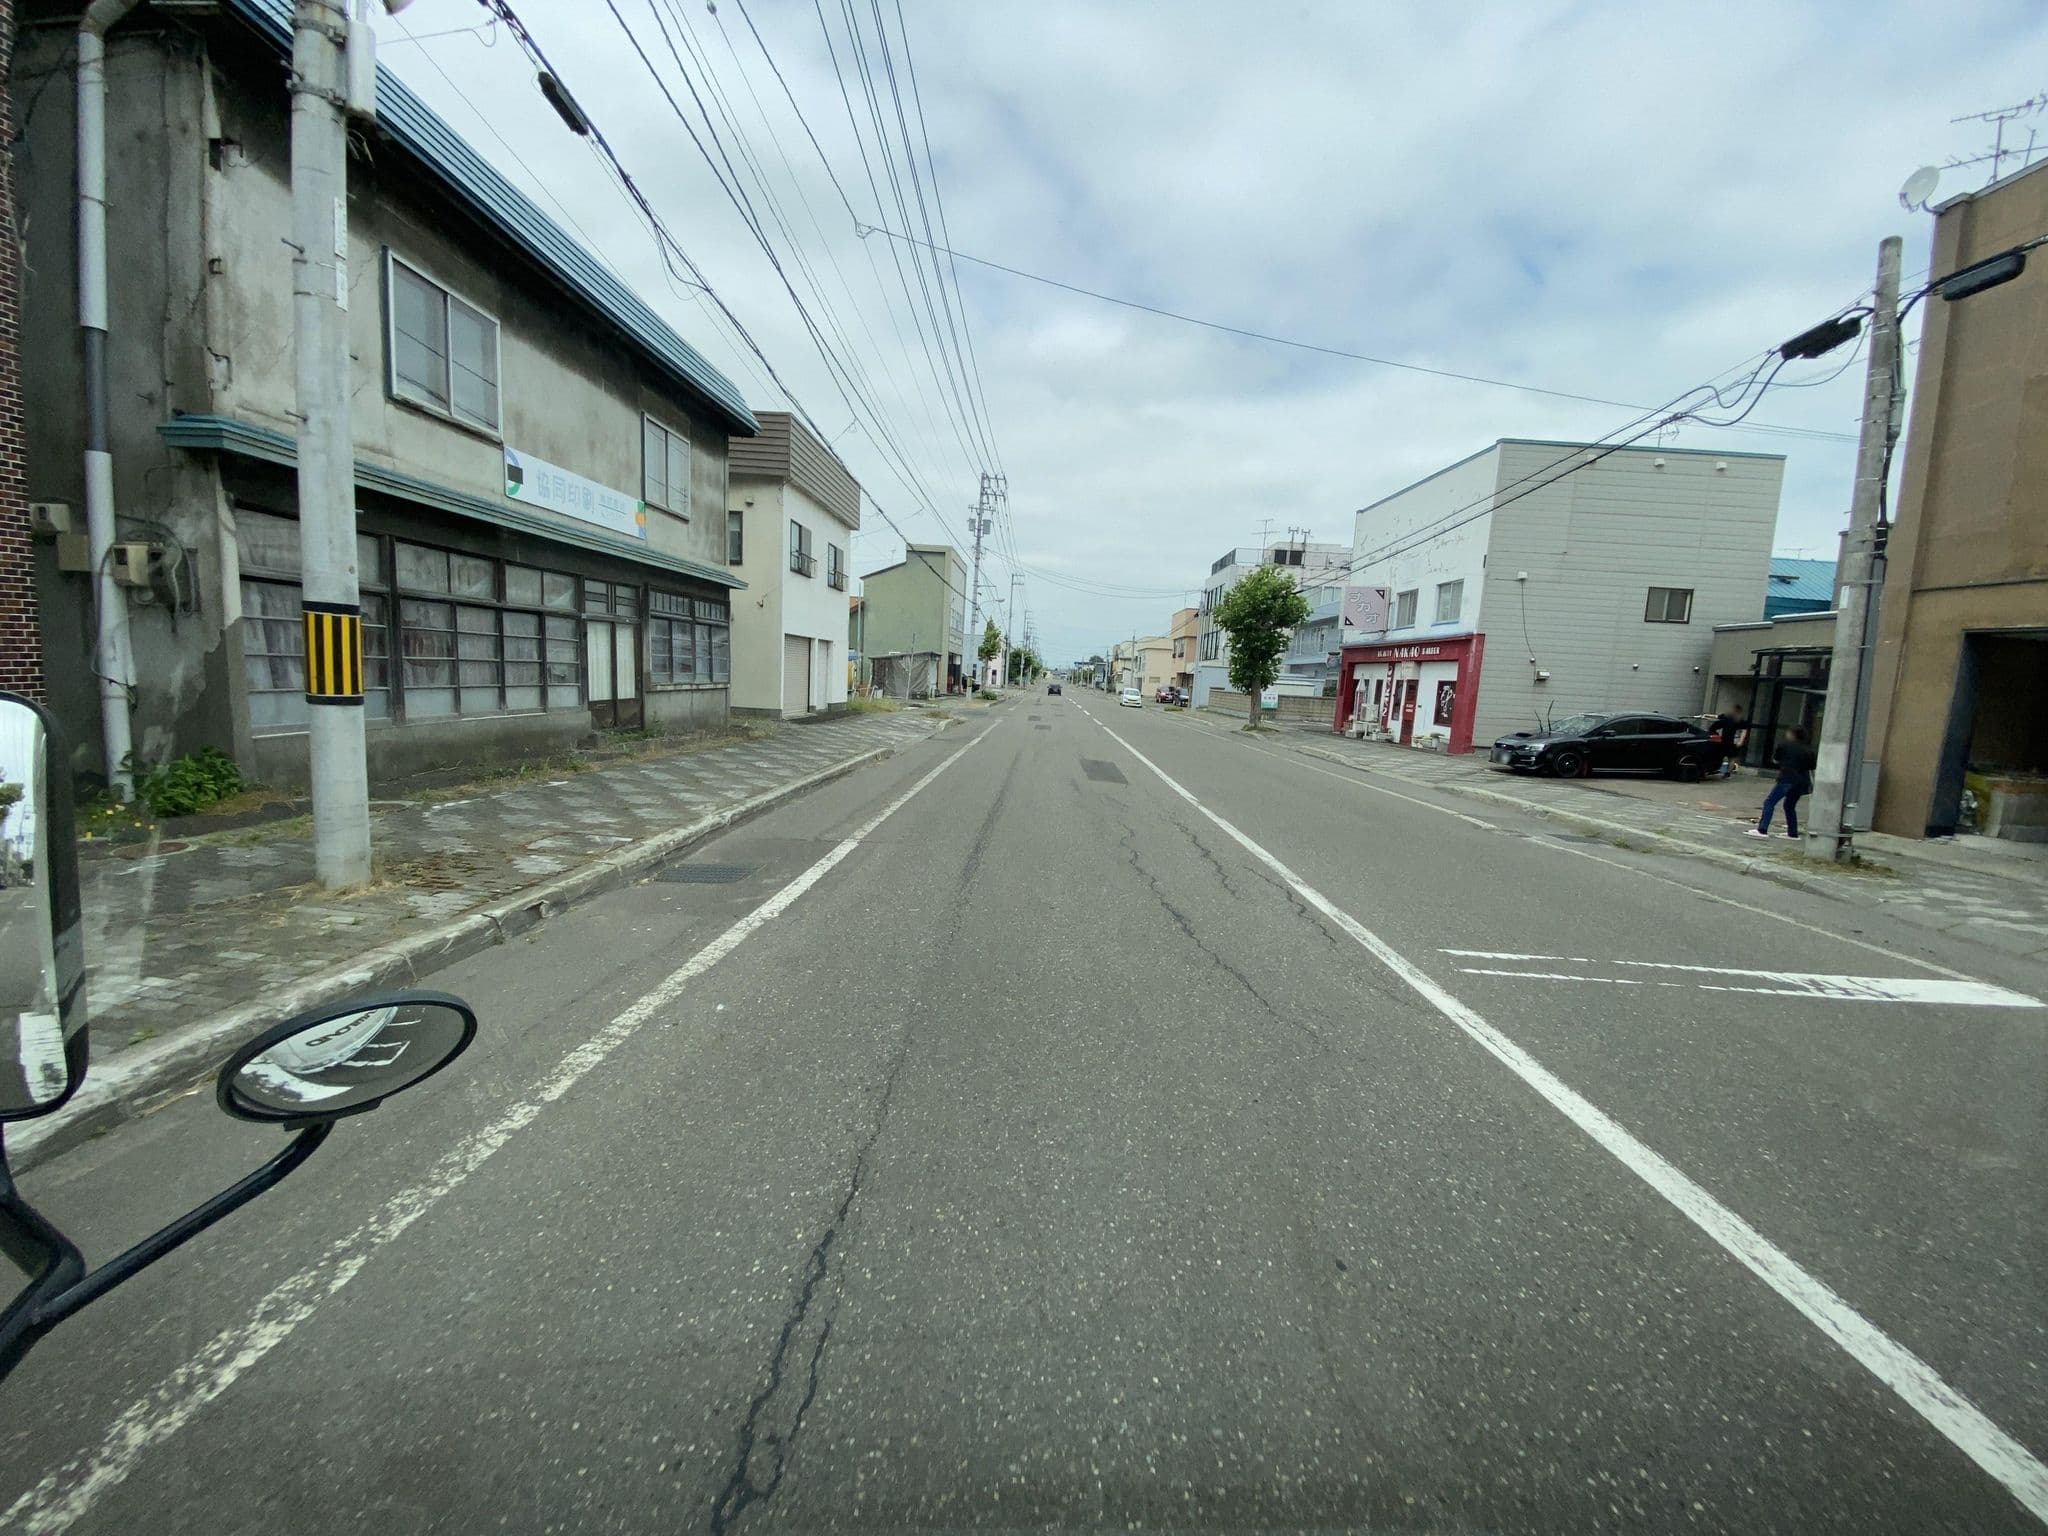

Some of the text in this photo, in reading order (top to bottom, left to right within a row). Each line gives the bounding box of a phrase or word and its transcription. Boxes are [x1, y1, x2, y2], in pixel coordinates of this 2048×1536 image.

[1350, 592, 1379, 623] ナカオ
[1394, 647, 1420, 658] NAKAO
